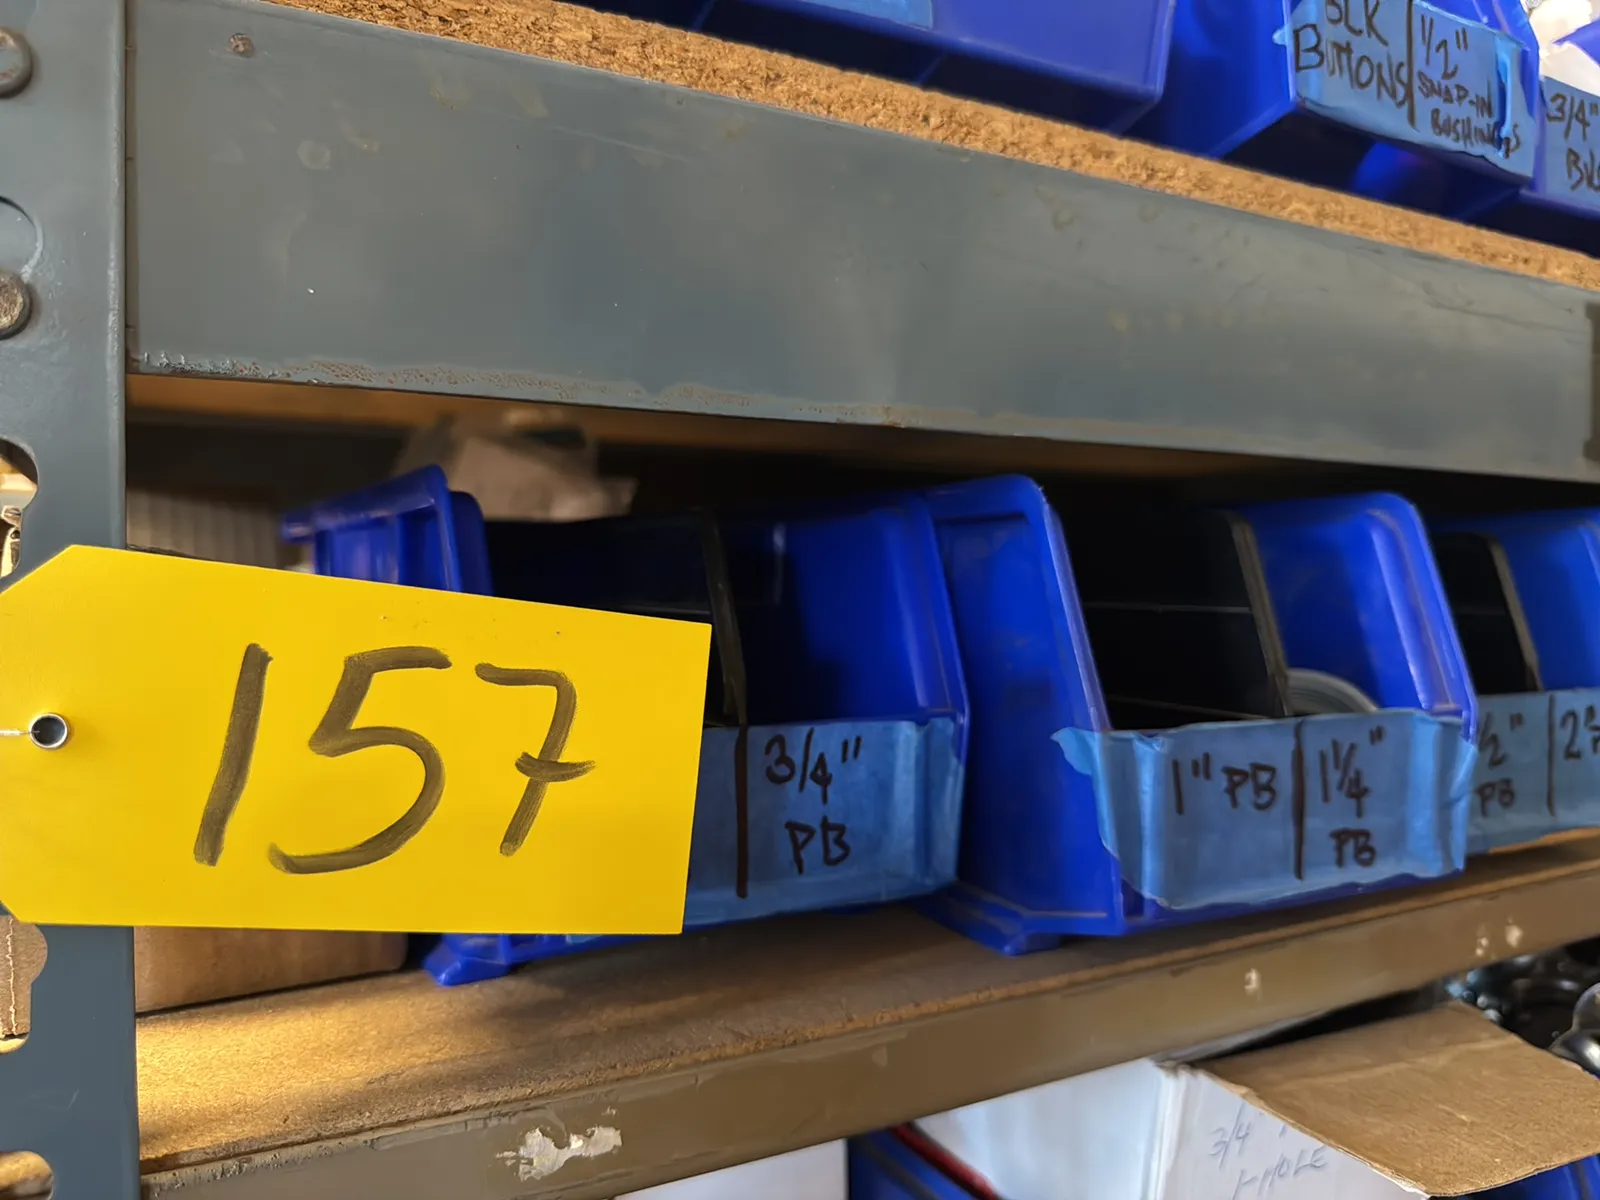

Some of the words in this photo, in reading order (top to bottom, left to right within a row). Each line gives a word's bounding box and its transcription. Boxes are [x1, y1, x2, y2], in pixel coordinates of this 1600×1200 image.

[193, 643, 596, 874] 157
[765, 727, 861, 805] 3/4"
[1222, 762, 1278, 812] PB
[785, 815, 851, 874] PB
[1330, 828, 1377, 868] PB
